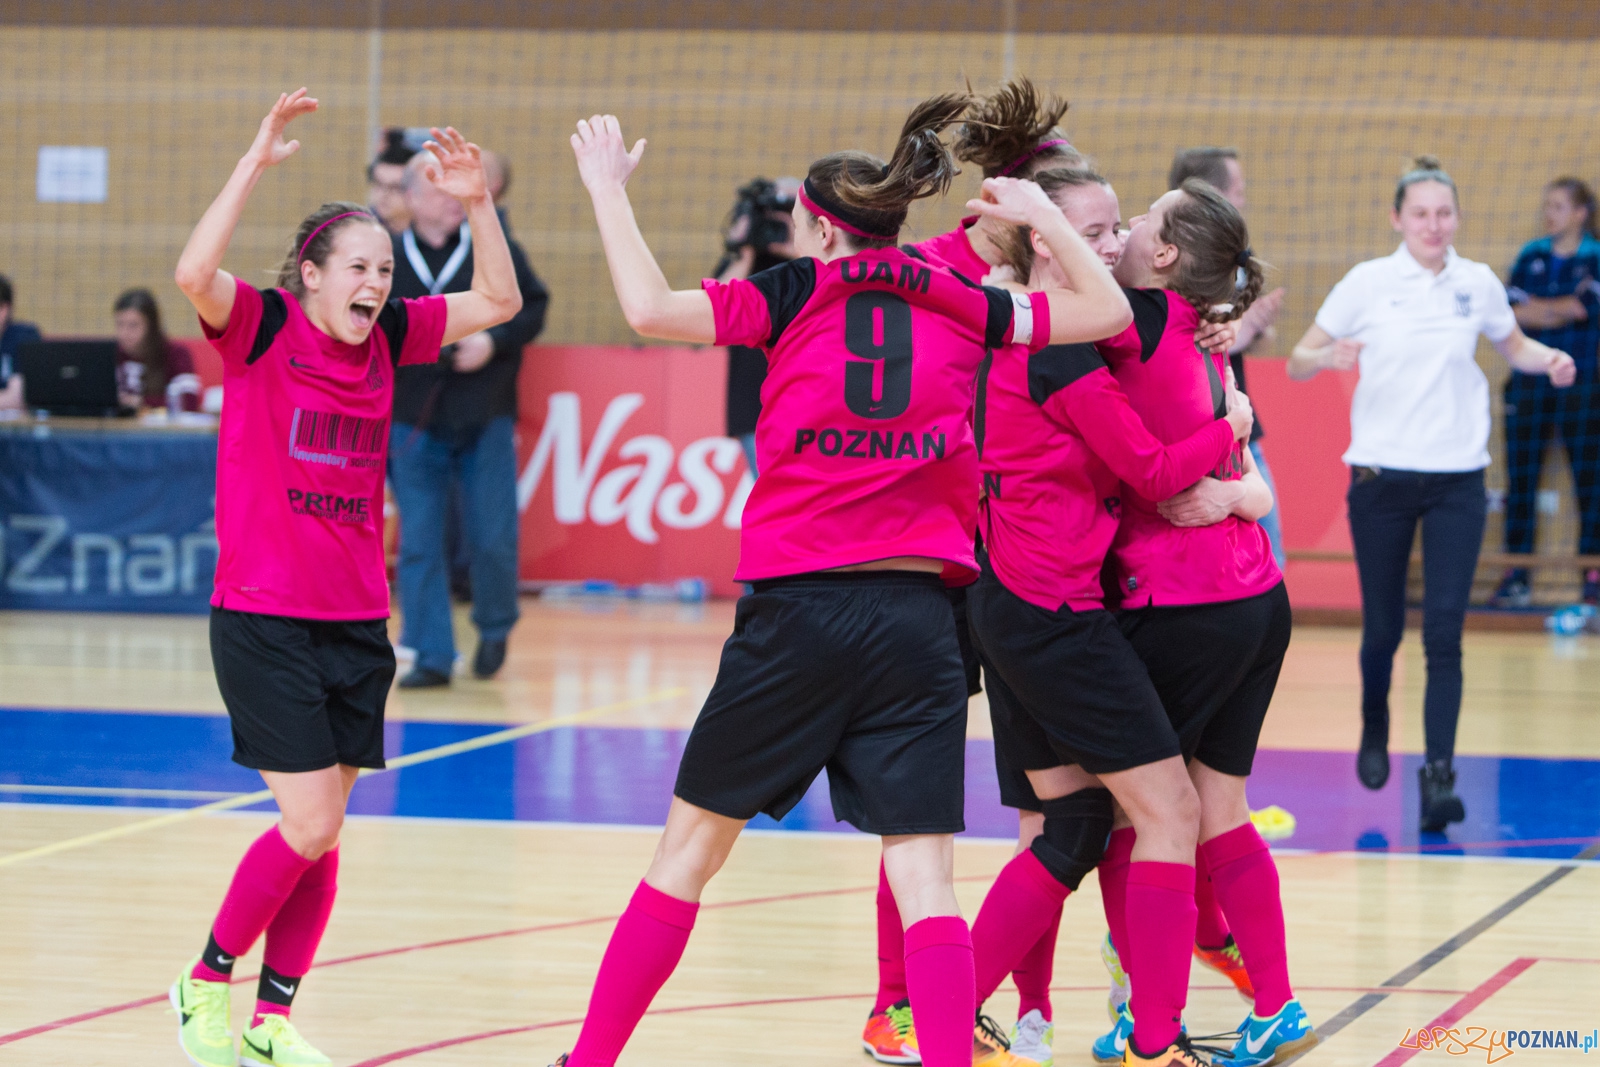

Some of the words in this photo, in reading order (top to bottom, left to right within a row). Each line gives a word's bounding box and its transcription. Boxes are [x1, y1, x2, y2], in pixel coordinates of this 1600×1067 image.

[840, 260, 931, 294] UAM
[844, 290, 913, 420] 9
[294, 446, 348, 470] inventory
[517, 391, 756, 544] Nas
[794, 425, 946, 460] POZNAŃ
[0, 513, 219, 595] Znań
